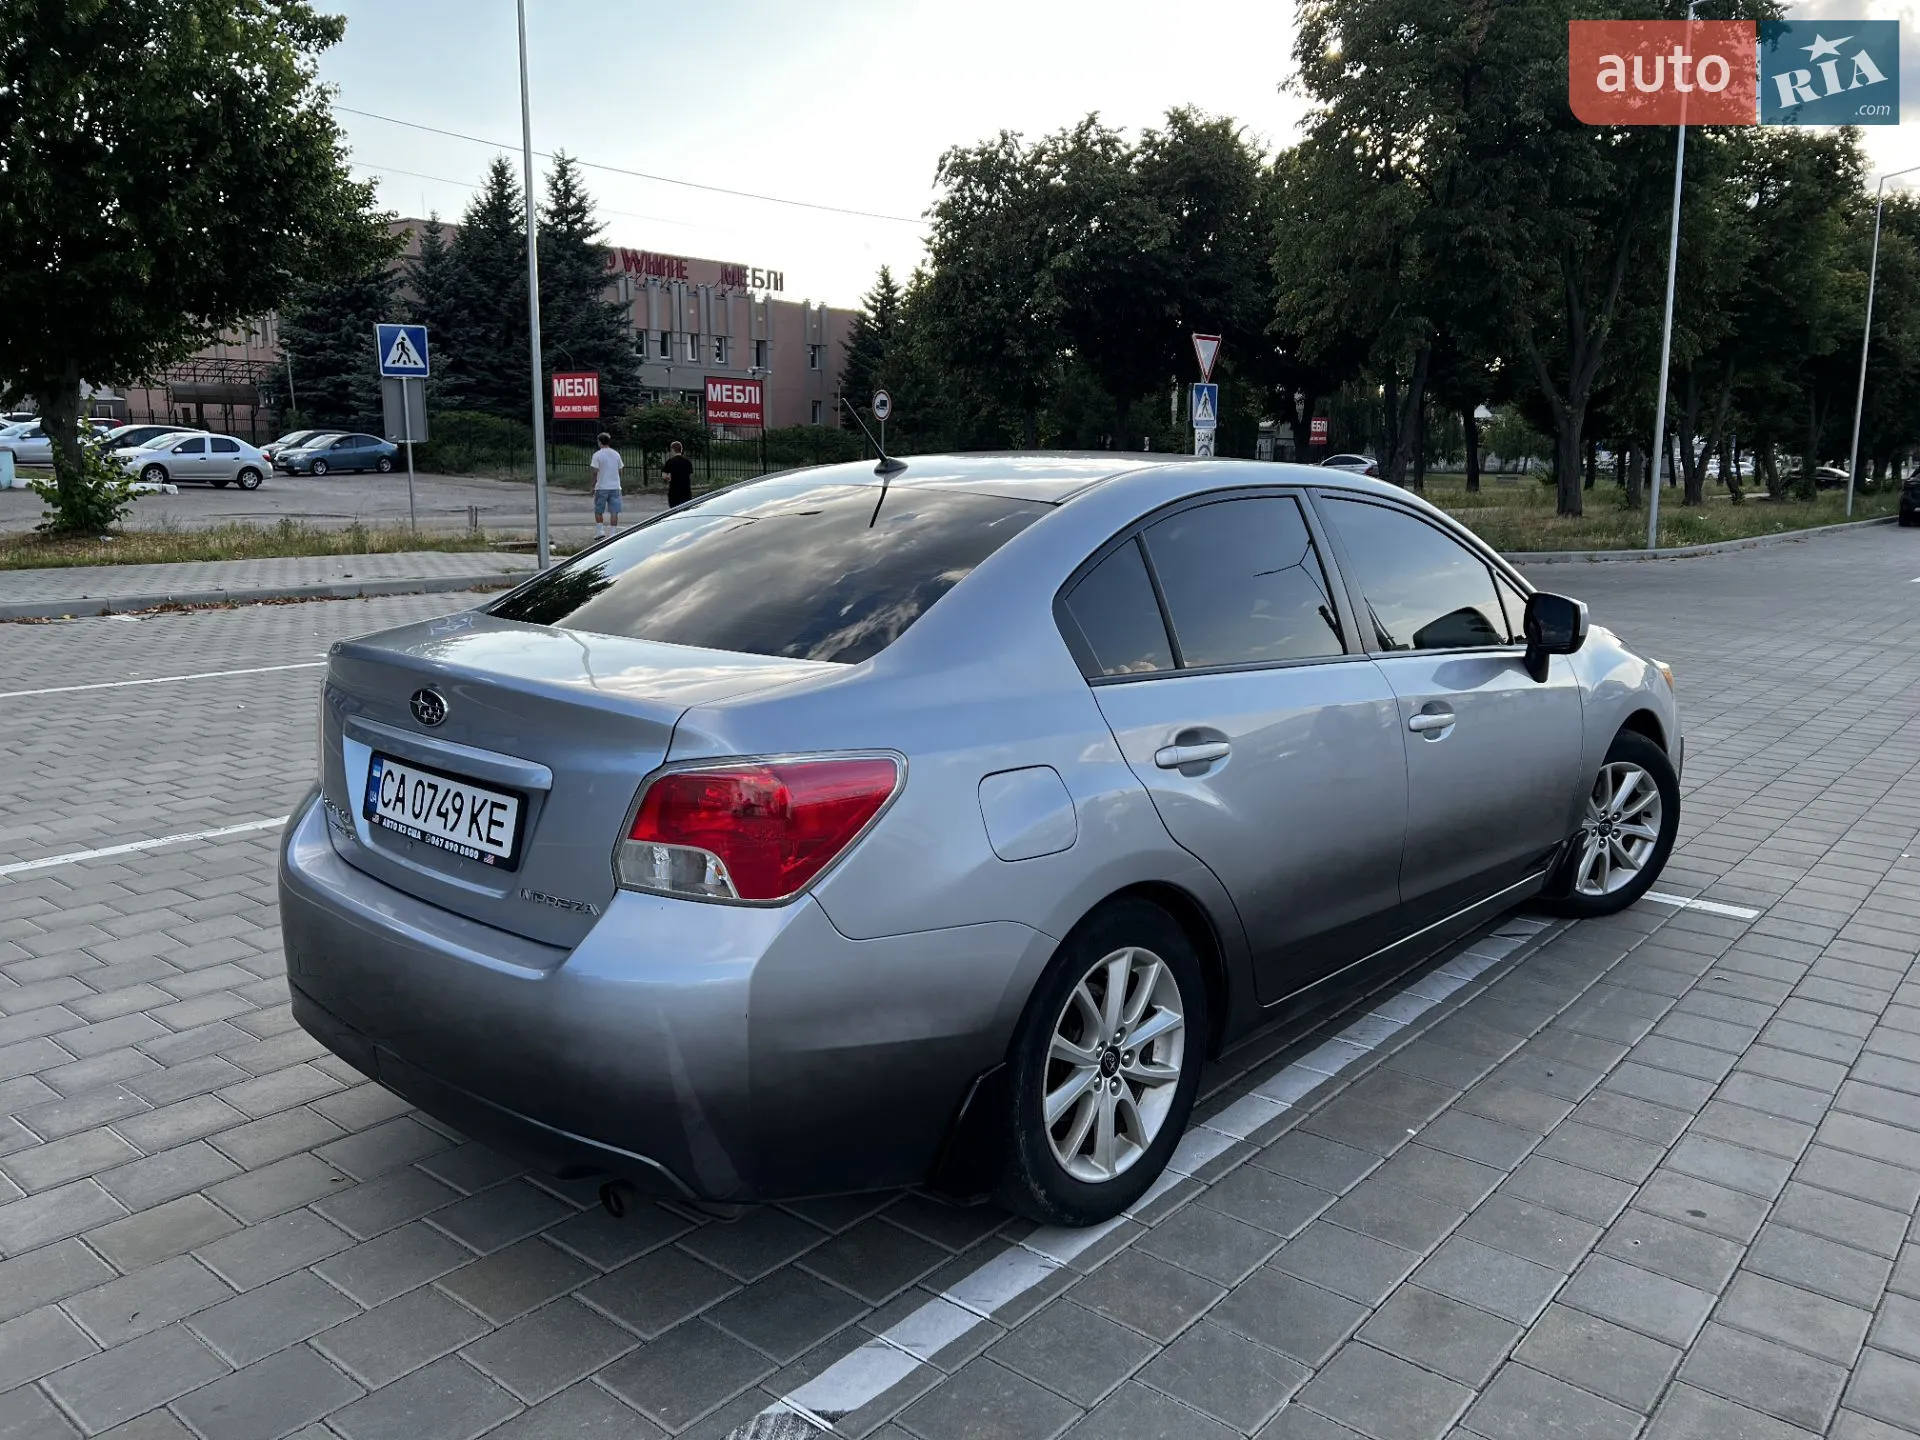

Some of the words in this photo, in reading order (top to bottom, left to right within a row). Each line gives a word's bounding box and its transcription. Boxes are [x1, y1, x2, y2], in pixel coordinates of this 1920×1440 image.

[620, 247, 689, 280] WHITE
[720, 263, 784, 292] МЕБЛІ
[553, 378, 598, 397] МЕБЛІ
[707, 383, 760, 405] МЕБЛІ
[554, 405, 571, 413] BLACK
[571, 405, 582, 413] RED
[582, 405, 598, 413] WHITE
[708, 410, 729, 418] BLACK
[730, 411, 742, 419] RED
[742, 412, 761, 420] WHITE
[1311, 420, 1328, 432] ЕБЛІ
[412, 779, 465, 833] 0749
[467, 795, 508, 848] KE
[382, 818, 398, 830] АВТО
[407, 827, 421, 840] США
[430, 835, 444, 848] 067
